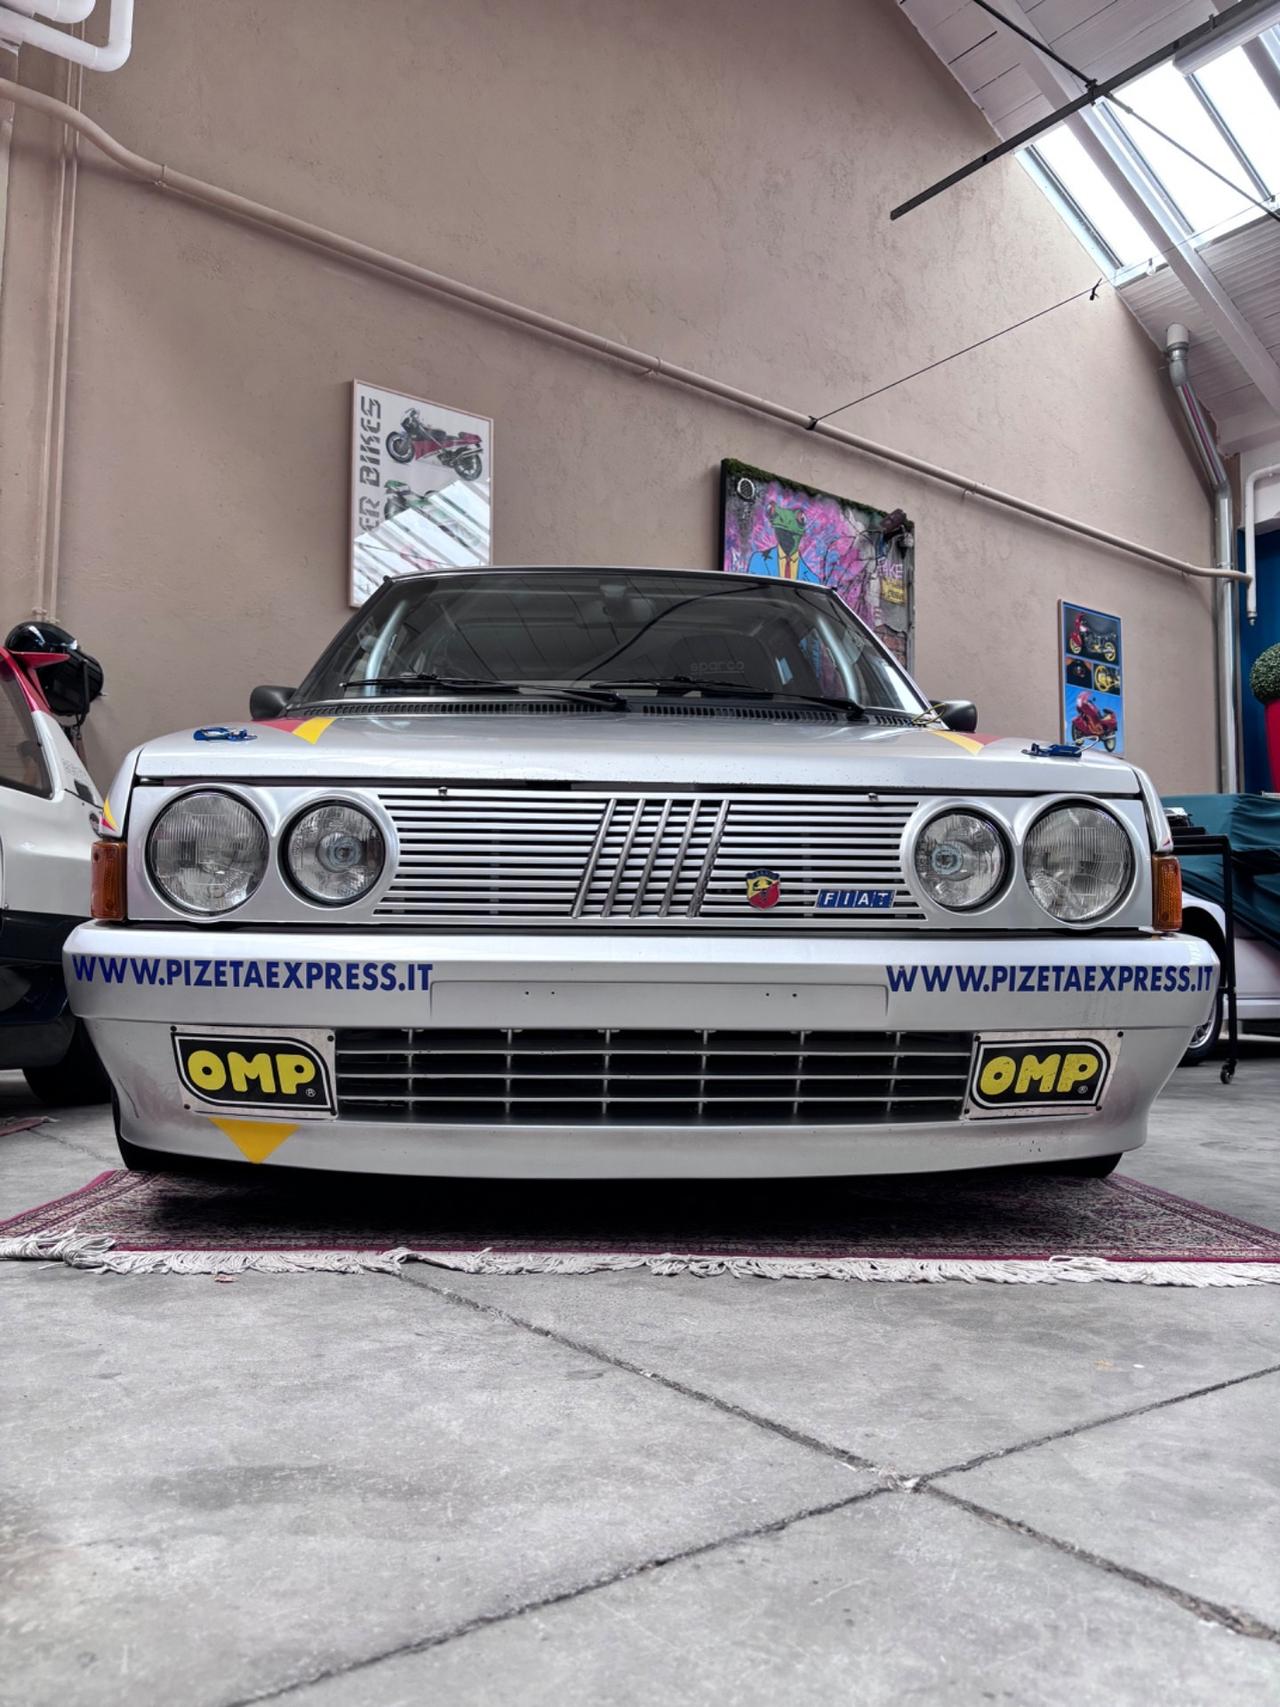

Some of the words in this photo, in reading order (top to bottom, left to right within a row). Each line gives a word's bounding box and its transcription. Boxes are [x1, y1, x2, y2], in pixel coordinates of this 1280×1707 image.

[360, 395, 382, 488] BIKES
[359, 496, 381, 532] ER
[823, 892, 889, 906] FIAT
[73, 955, 433, 991] WWW.PIZETAEXPRESS.IT
[886, 965, 1214, 993] WWW.PIZETAEXPRESS.IT
[187, 1050, 317, 1095] OMP
[979, 1053, 1099, 1096] OMP
